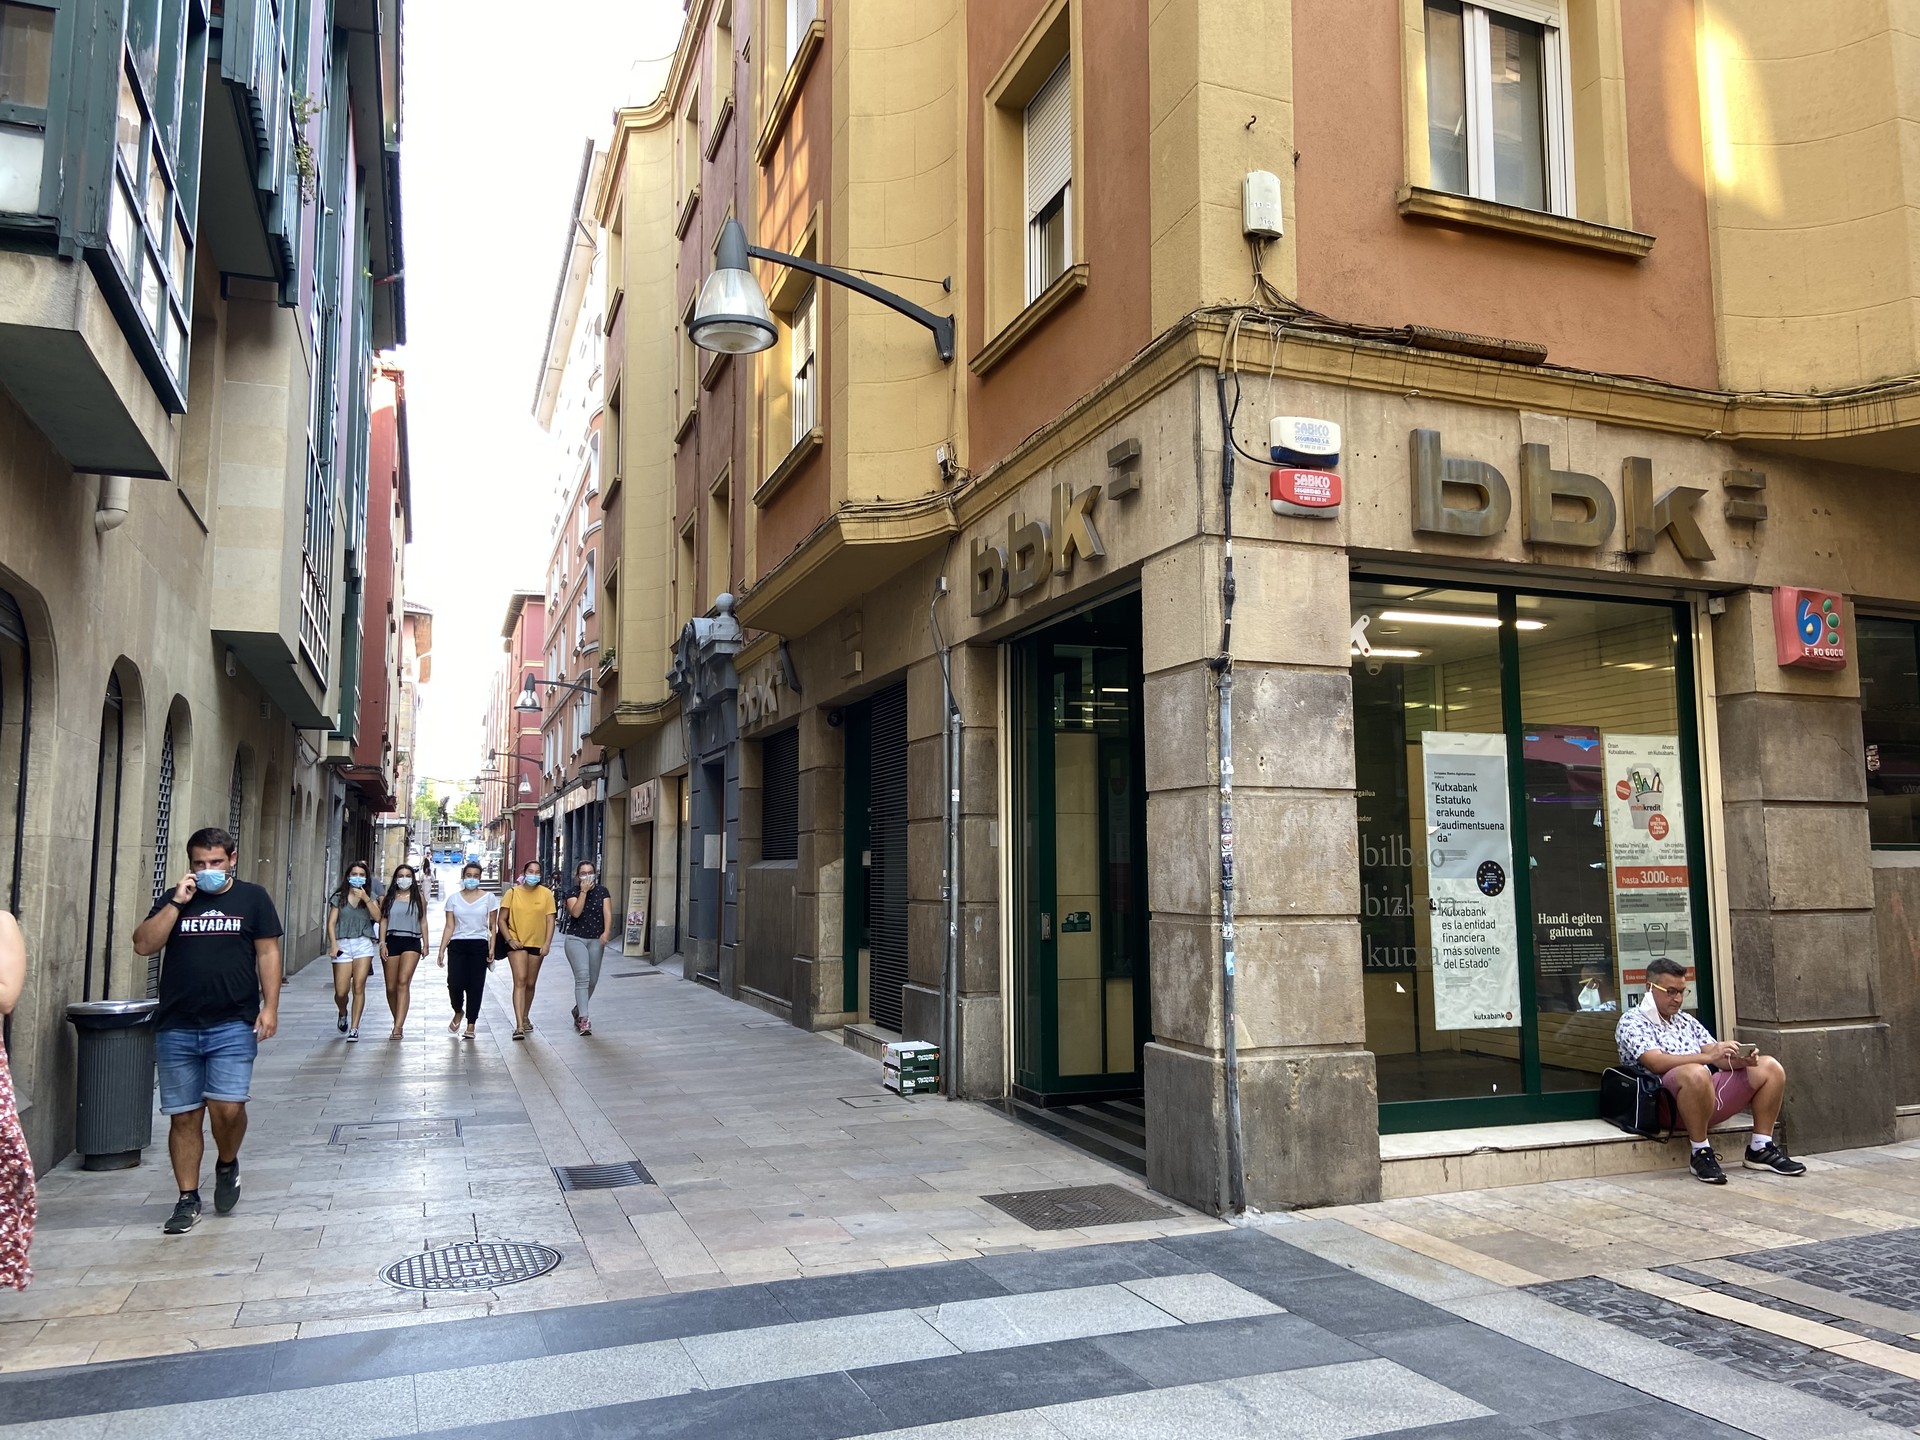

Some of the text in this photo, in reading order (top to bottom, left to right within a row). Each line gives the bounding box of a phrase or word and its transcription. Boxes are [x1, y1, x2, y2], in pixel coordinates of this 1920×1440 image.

[1294, 422, 1330, 437] SABICO
[1294, 474, 1330, 488] SABICO
[1436, 794, 1471, 804] Estatuko
[1436, 808, 1475, 817] erakunde
[1437, 820, 1504, 830] kaudimentsuena
[1622, 876, 1639, 884] hasta
[1538, 912, 1603, 926] Handi egiten
[181, 919, 241, 932] NEVADAH
[1442, 920, 1496, 930] es la entidad
[1442, 933, 1486, 943] financiera
[1549, 926, 1593, 940] gaituena
[1443, 946, 1500, 956] más solvente
[1444, 959, 1457, 969] del
[1473, 1012, 1505, 1020] kutxabank
